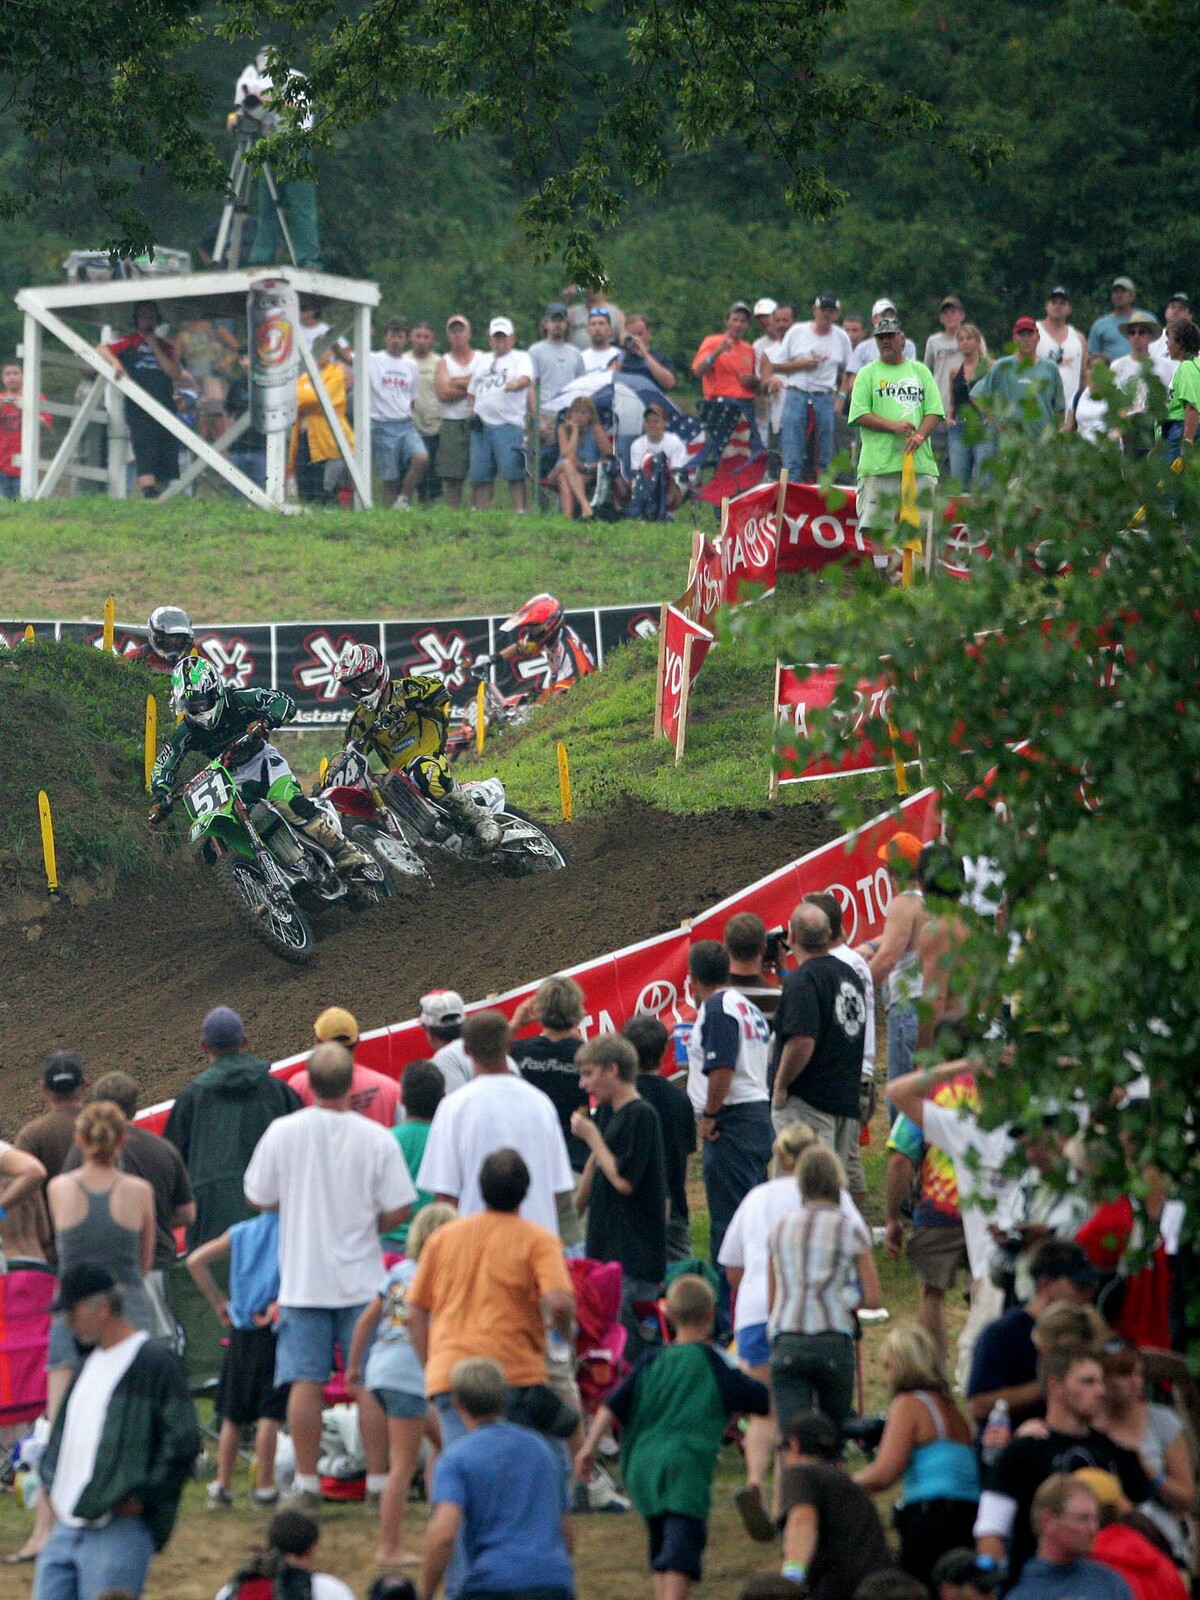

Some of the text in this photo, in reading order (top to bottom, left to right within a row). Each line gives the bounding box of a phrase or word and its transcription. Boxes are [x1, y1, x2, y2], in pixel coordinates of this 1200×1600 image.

[875, 386, 925, 399] TRACK
[289, 708, 355, 724] Asteris
[191, 773, 229, 817] 51
